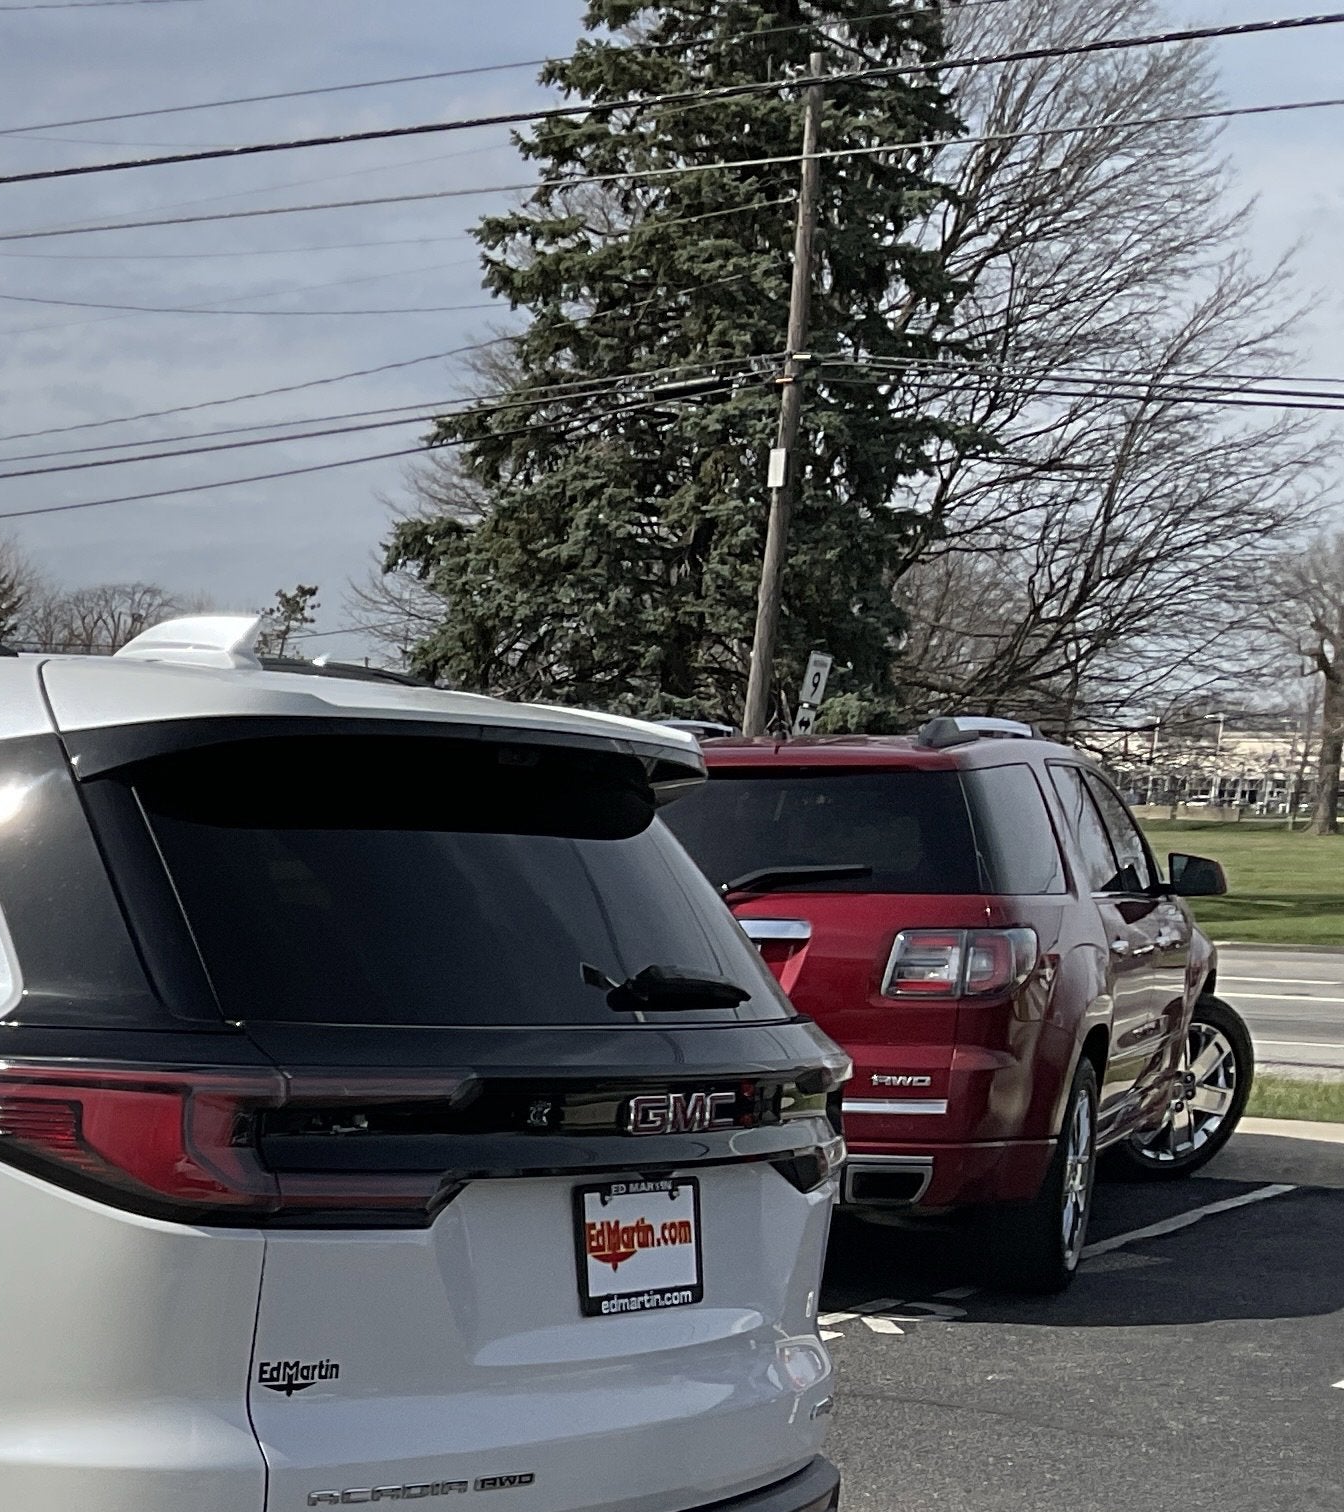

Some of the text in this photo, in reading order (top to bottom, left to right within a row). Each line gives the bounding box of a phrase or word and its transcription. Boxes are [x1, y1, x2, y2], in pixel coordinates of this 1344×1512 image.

[810, 671, 821, 697] 9
[872, 1074, 931, 1087] AWD
[628, 1092, 736, 1135] GMC
[611, 1183, 627, 1194] ED
[601, 1290, 692, 1314] edmartin.com
[307, 1472, 535, 1507] ACADIA AWD
